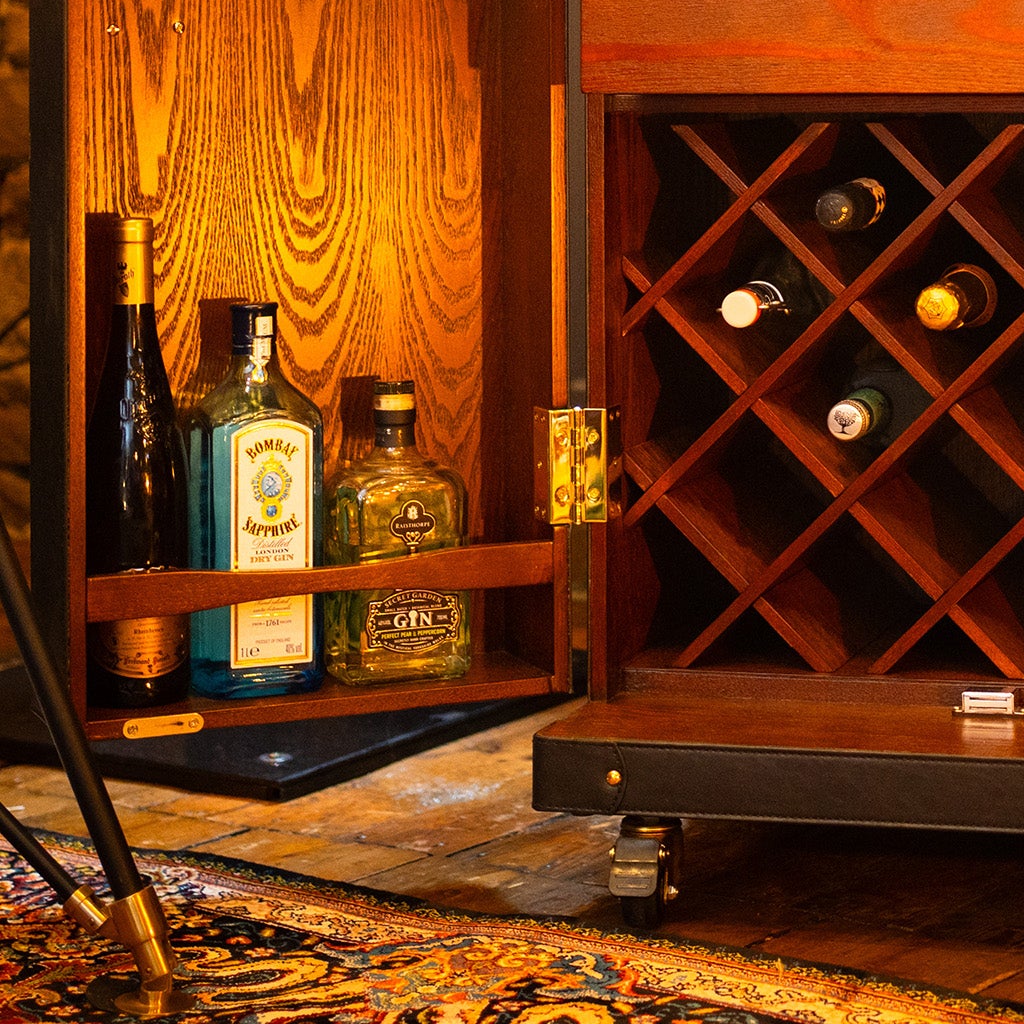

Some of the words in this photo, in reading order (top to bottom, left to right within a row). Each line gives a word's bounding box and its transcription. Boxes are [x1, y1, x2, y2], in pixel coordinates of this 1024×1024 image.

[245, 438, 299, 464] BOMBAY
[242, 513, 300, 537] SAPPHIRE
[250, 554, 272, 564] DRY
[273, 553, 294, 562] GIN
[384, 593, 410, 608] SECRET
[411, 592, 443, 603] GARDEN
[265, 619, 280, 627] 1761
[393, 610, 433, 628] GIN
